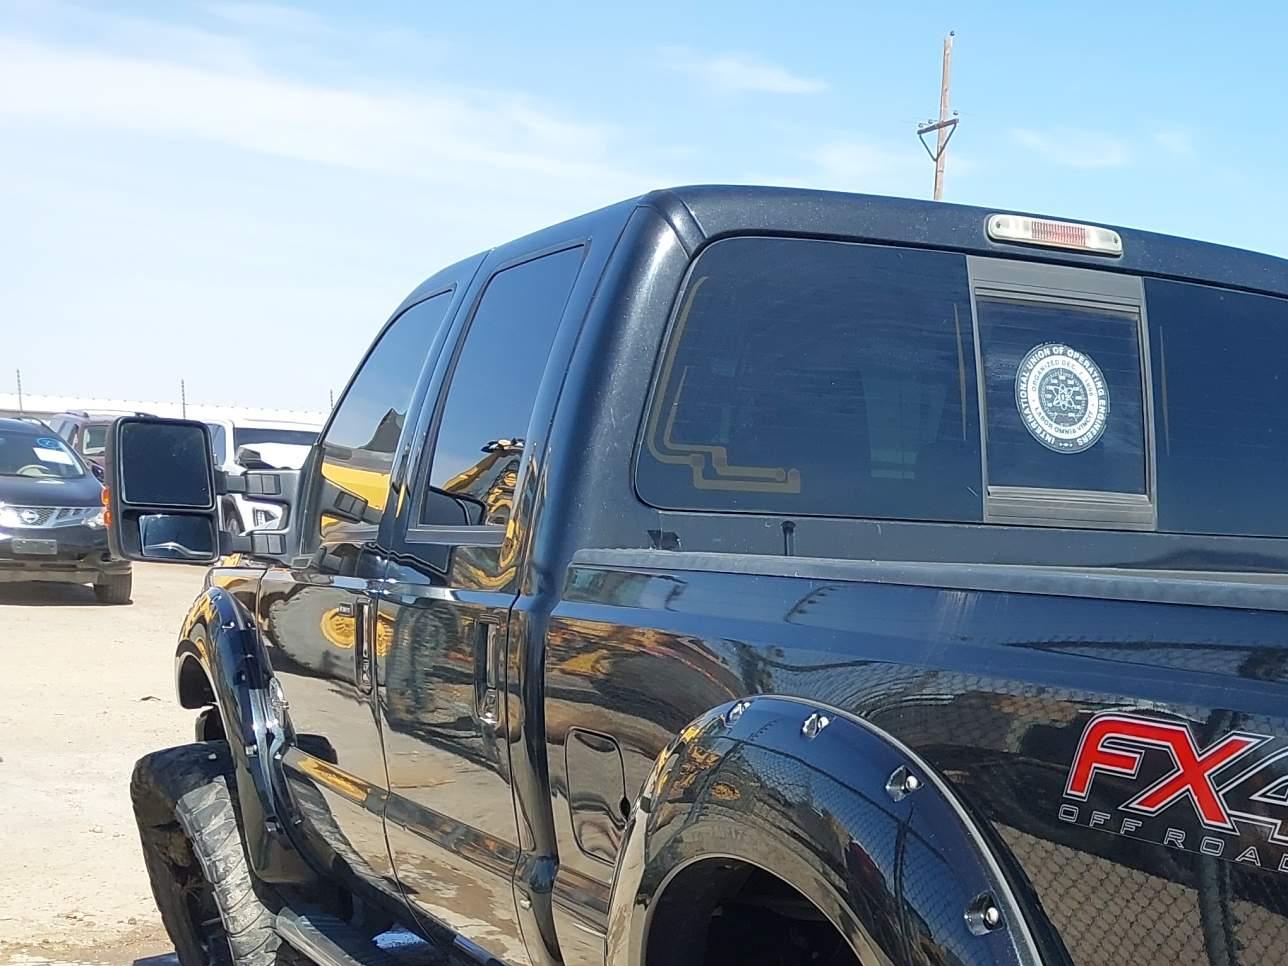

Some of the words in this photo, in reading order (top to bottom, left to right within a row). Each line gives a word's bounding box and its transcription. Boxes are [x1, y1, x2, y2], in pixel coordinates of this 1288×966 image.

[1026, 347, 1051, 370] UNION
[1052, 346, 1065, 355] OF
[1066, 349, 1105, 397] OPERATING
[1019, 369, 1056, 445] INTERNATIONAL
[1076, 399, 1107, 446] ENGINEERS
[1058, 803, 1143, 836] OFF
